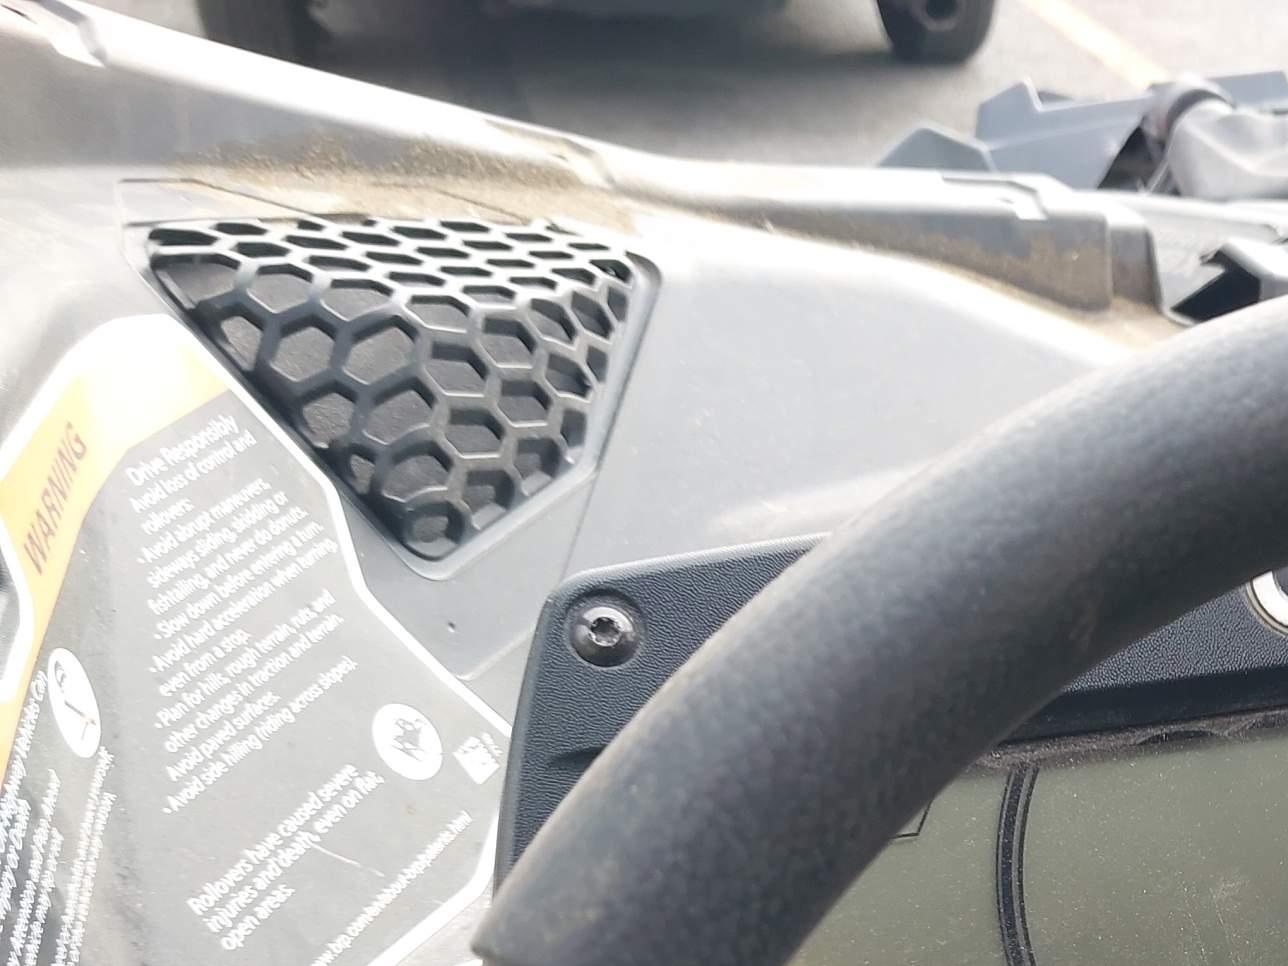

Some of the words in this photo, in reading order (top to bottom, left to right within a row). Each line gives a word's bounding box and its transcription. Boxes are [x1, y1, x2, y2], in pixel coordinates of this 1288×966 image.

[24, 422, 89, 576] WARNING
[126, 458, 167, 485] Drive
[161, 413, 239, 464] Responsibly
[129, 483, 167, 513] Avoid
[160, 474, 188, 493] loss
[184, 462, 200, 480] of
[197, 442, 236, 473] control
[233, 430, 256, 451] and
[141, 499, 193, 534] rollovers:
[141, 532, 178, 562] Avoid
[175, 512, 214, 541] abrupt
[211, 479, 270, 518] maneuvers,
[148, 551, 198, 587] sideways
[196, 528, 236, 556] sliding,
[232, 500, 279, 532] skidding
[274, 491, 288, 505] or
[148, 575, 209, 614] fishtailing,
[204, 555, 230, 578] and
[225, 539, 256, 564] never
[254, 530, 272, 544] do
[269, 507, 308, 534] donuts.
[152, 639, 190, 671] Avoid
[184, 621, 215, 647] hard
[213, 583, 274, 629] acceleration
[271, 563, 302, 586] when
[157, 613, 189, 637] Slow
[186, 593, 220, 618] down
[214, 570, 254, 597] before
[251, 542, 296, 574] entering
[290, 536, 302, 546] a
[296, 522, 323, 541] turn.
[156, 703, 188, 726] Plan
[182, 689, 204, 708] for
[198, 673, 230, 695] hills,
[225, 648, 260, 676] rough
[255, 624, 296, 653] terrain,
[290, 608, 317, 628] ruts,
[312, 589, 335, 612] and
[159, 672, 190, 696] even
[184, 653, 216, 676] from
[212, 647, 225, 657] a
[221, 629, 250, 652] stop.
[164, 724, 197, 752] other
[196, 691, 243, 728] changes
[236, 682, 254, 696] in
[249, 653, 292, 686] traction
[288, 634, 311, 657] and
[306, 615, 344, 642] terrain.
[166, 747, 203, 781] Avoid
[200, 721, 236, 758] paved
[232, 692, 280, 729] surfaces.
[168, 776, 204, 810] Avoid
[200, 762, 228, 784] side
[222, 735, 262, 765] hilling
[255, 709, 295, 740] (riding
[290, 684, 323, 712] across
[319, 656, 357, 689] slopes).
[188, 860, 252, 914] Rollovers
[243, 833, 283, 864] have
[278, 792, 322, 836] caused
[318, 765, 358, 801] severe
[204, 886, 262, 932] injuries
[253, 859, 282, 889] and
[314, 805, 346, 833] even
[342, 790, 363, 808] on
[355, 771, 384, 794] flat,
[221, 916, 259, 949] open
[255, 885, 294, 918] areas.
